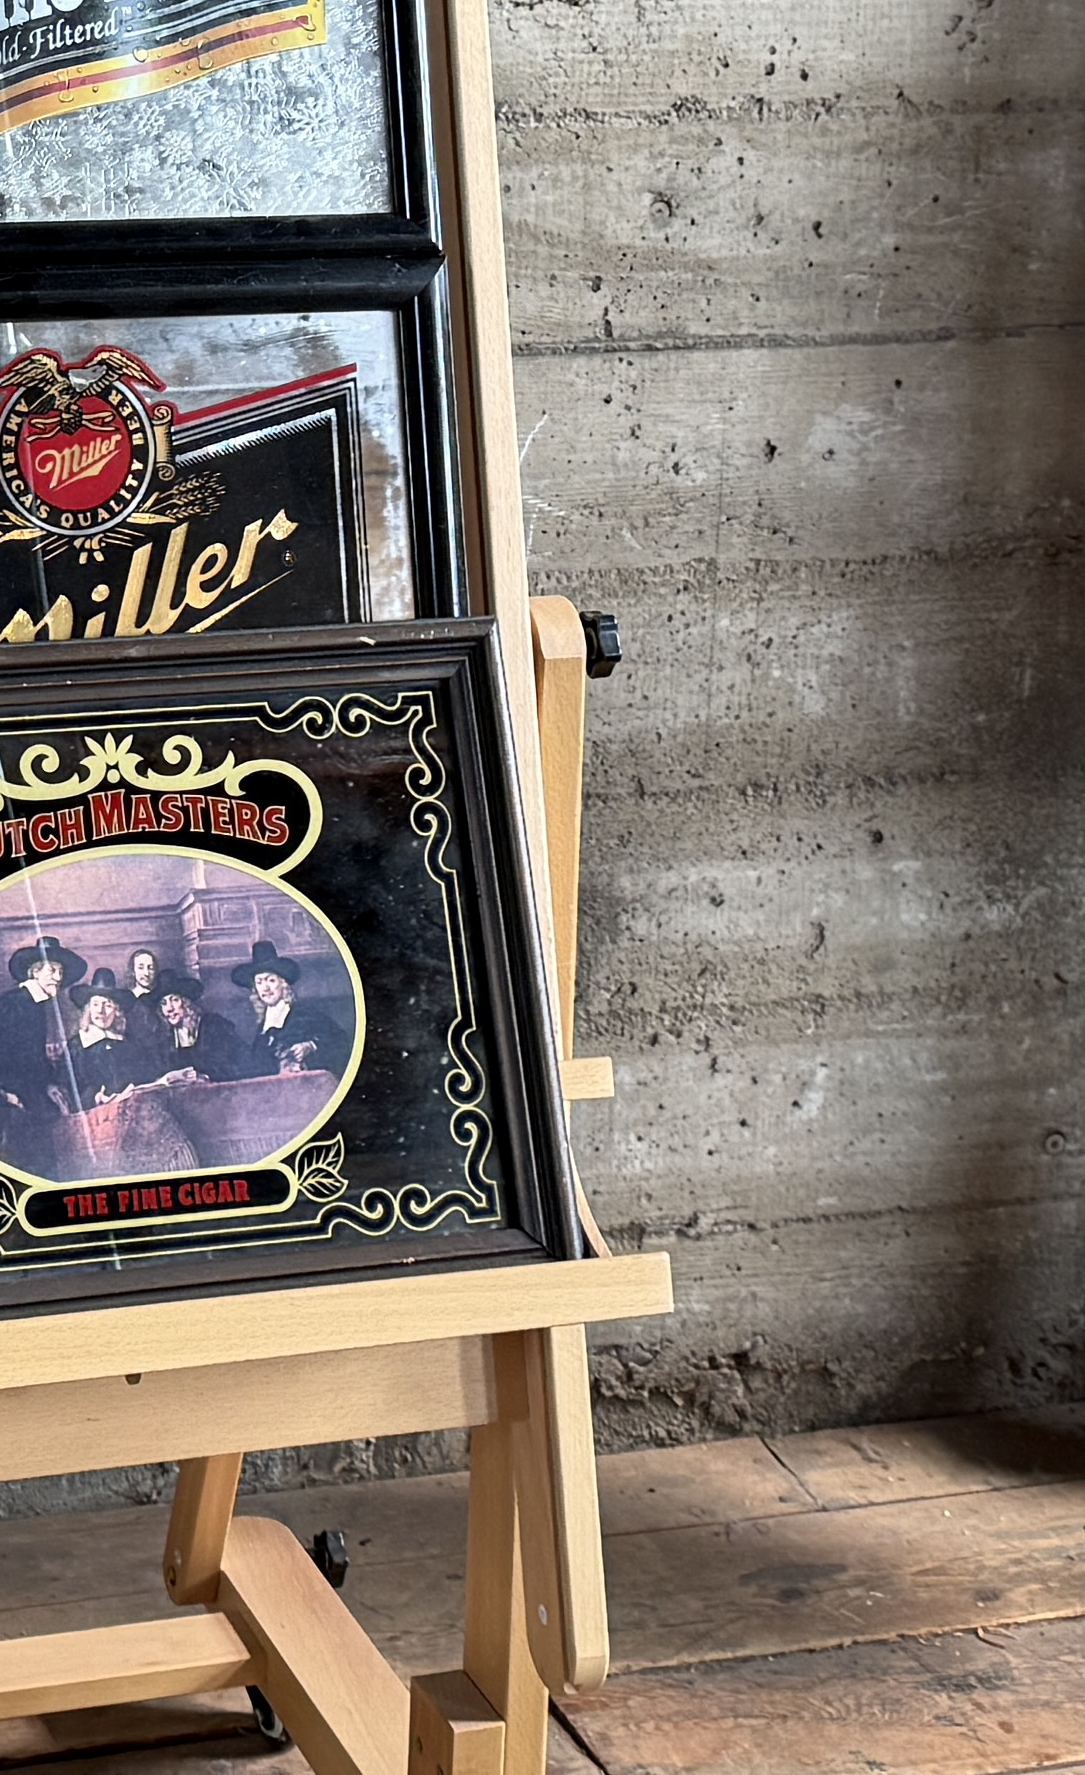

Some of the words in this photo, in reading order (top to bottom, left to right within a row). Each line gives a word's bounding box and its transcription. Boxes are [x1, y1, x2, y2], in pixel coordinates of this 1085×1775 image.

[1, 397, 50, 519] AMERICA'S
[60, 458, 144, 528] QUALITY
[109, 389, 145, 445] BEER
[34, 433, 123, 490] Miller
[88, 788, 290, 846] MASTERS
[63, 1193, 109, 1219] THE
[118, 1185, 173, 1214] FINE
[178, 1179, 251, 1206] CIGAR
